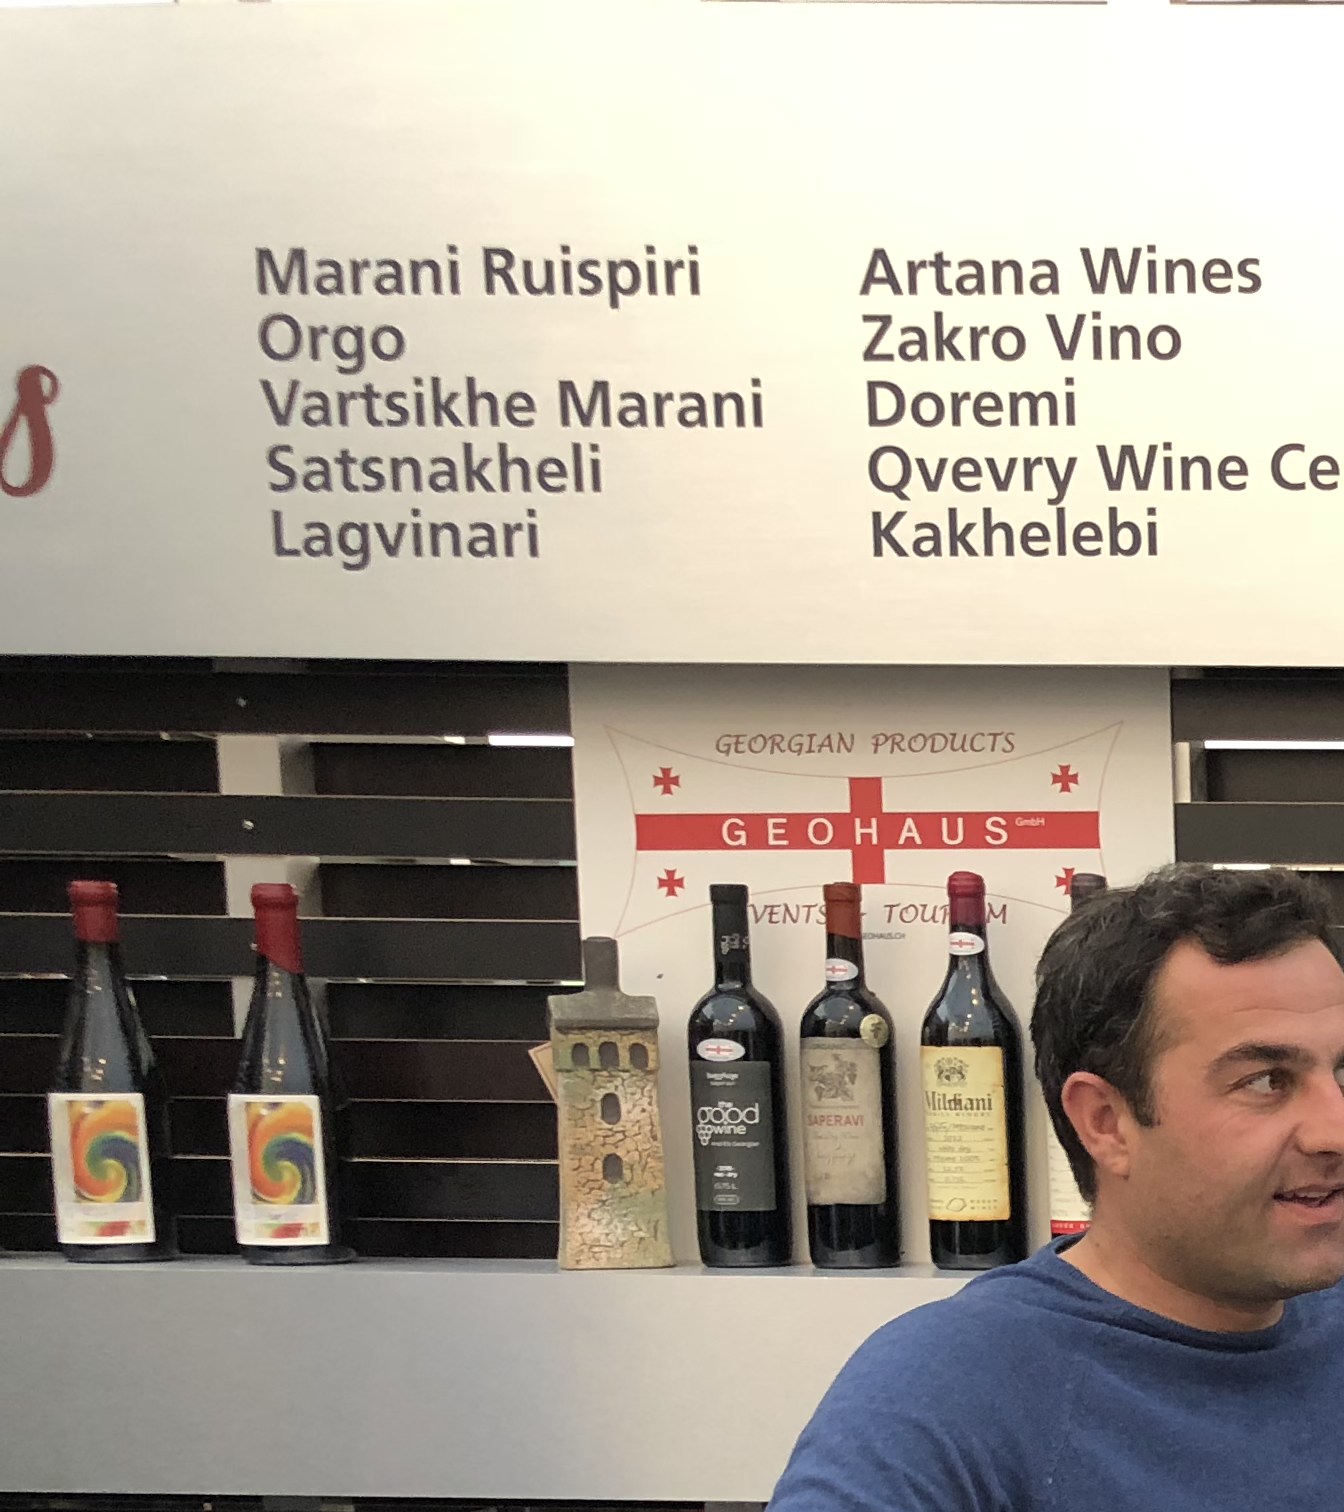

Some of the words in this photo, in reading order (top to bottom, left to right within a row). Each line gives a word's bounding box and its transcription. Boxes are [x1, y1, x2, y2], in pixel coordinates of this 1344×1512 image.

[255, 245, 462, 297] Marani
[482, 244, 702, 310] Ruispiri
[860, 247, 1060, 297] Artana
[1080, 244, 1263, 295] Wines
[258, 313, 407, 374] Orgo
[861, 311, 1027, 362] Zakro
[1045, 310, 1183, 361] Vino
[260, 377, 538, 429] Vartsikhe
[558, 377, 764, 429] Marani
[866, 377, 1077, 428] Doremi
[266, 442, 603, 494] Satsnakheli
[867, 444, 1078, 505] Qvevry
[1096, 441, 1250, 491] Wine
[271, 507, 540, 571] Lagvinari
[871, 506, 1160, 558] Kakhelebi
[715, 731, 855, 757] GEORGIAN
[872, 730, 1016, 755] PRODUCTS
[721, 816, 1010, 846] GEOHAUS
[1014, 816, 1046, 828] GmbH
[748, 902, 827, 925] VENTS
[697, 1102, 760, 1127] good
[712, 1121, 747, 1135] wine
[807, 1114, 865, 1127] SAPERAVI
